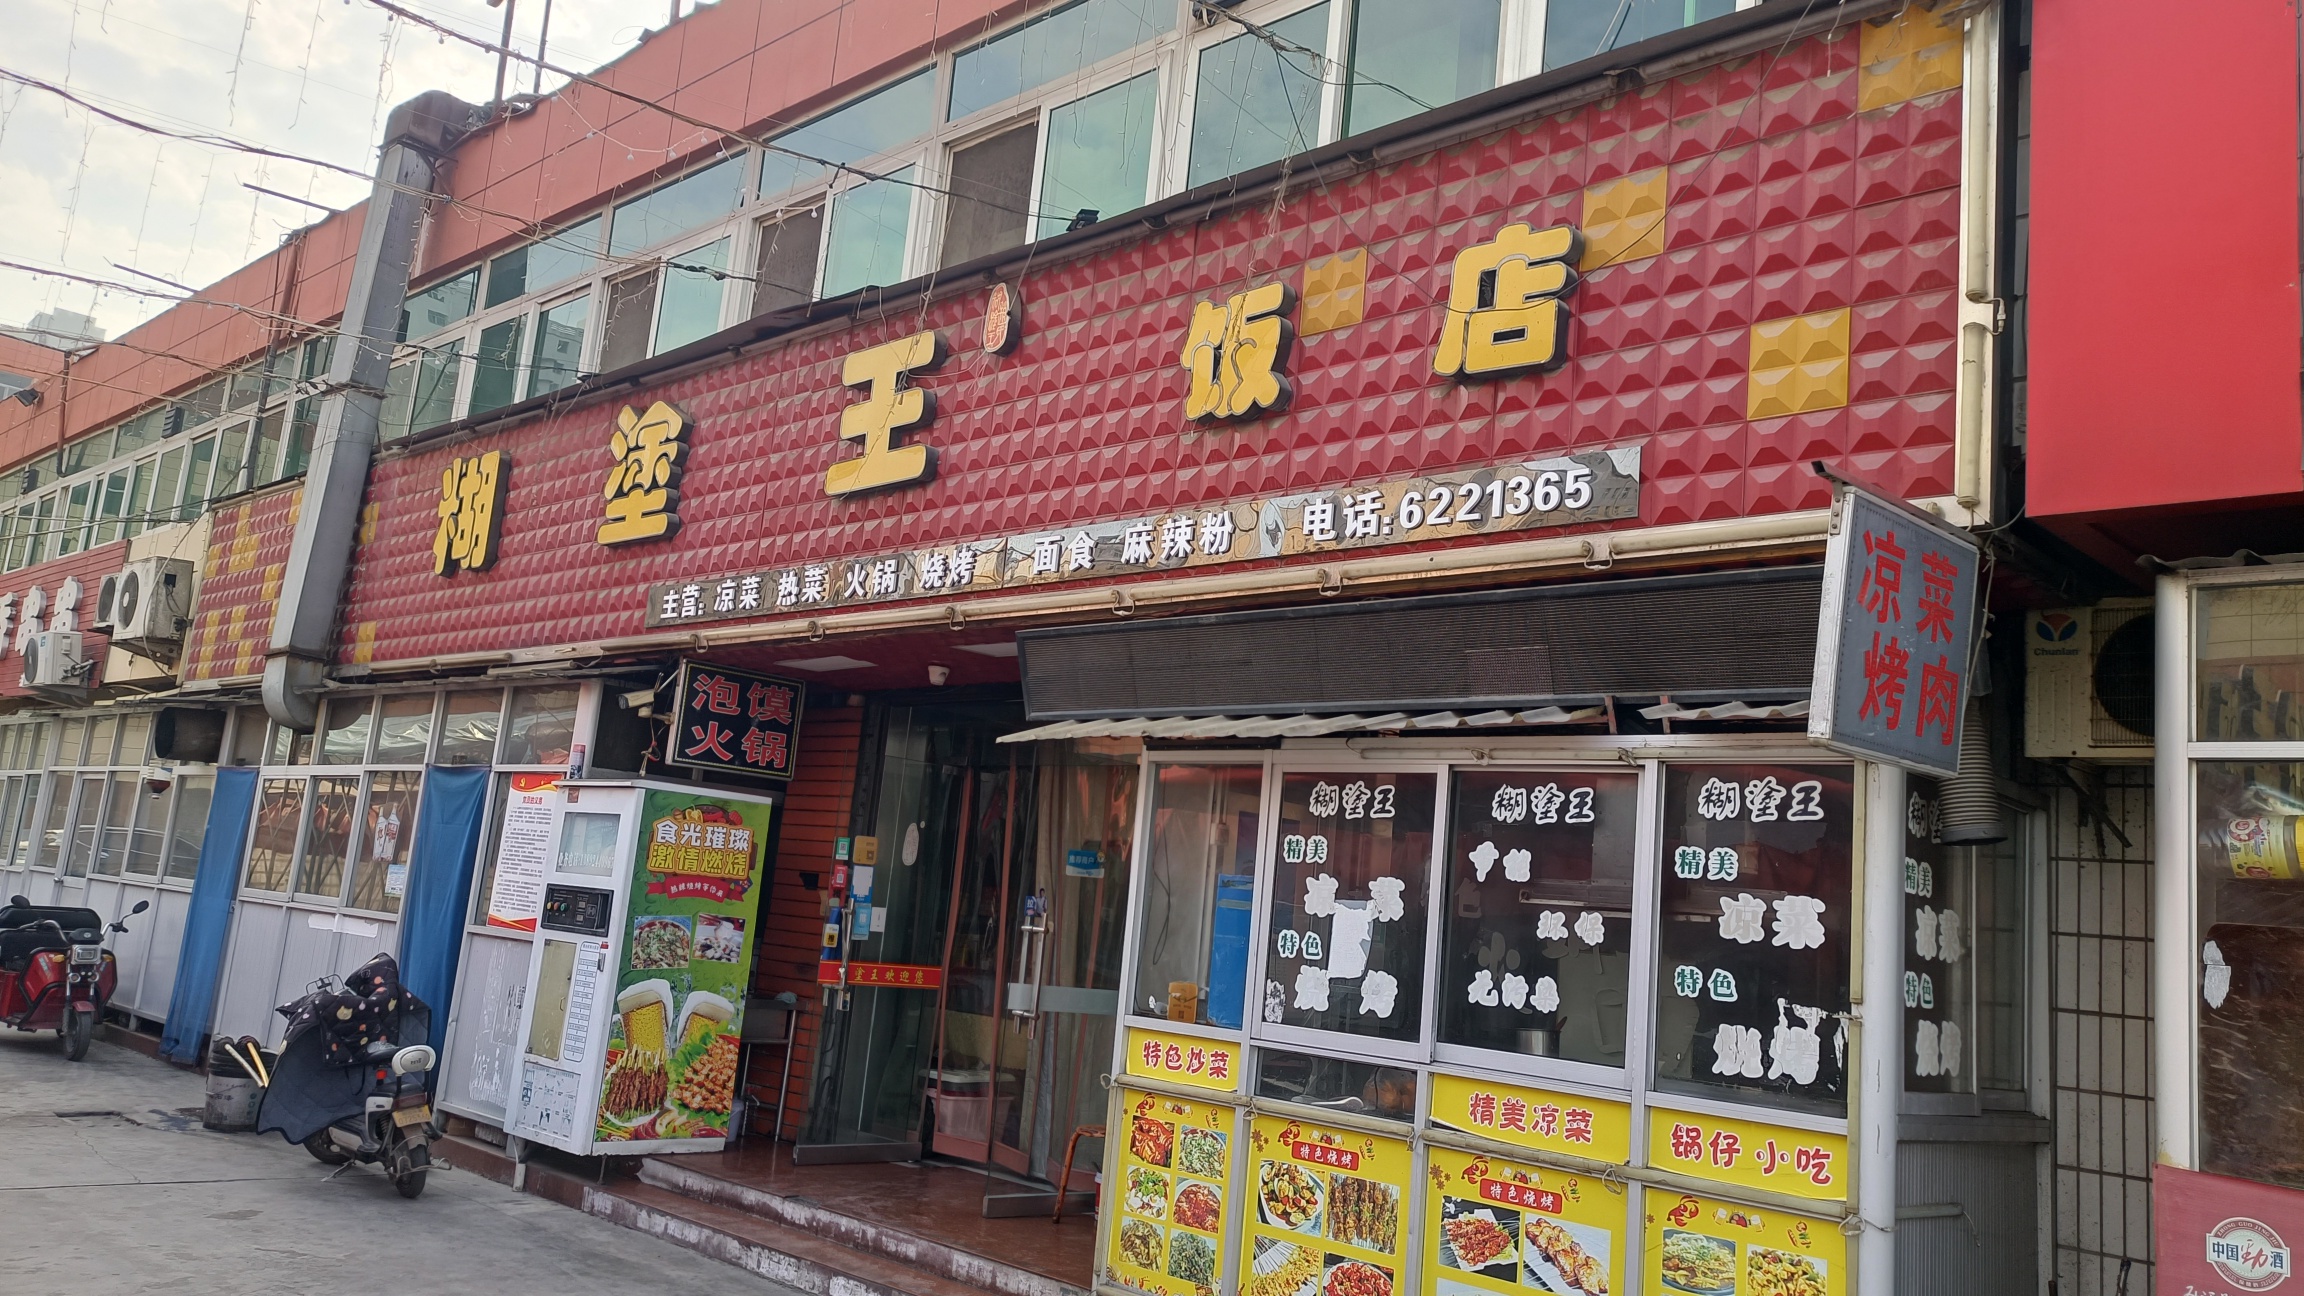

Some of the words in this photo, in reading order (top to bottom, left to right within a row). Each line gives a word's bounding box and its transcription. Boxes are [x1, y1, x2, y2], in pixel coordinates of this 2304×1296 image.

[713, 576, 761, 611] 凉菜
[776, 567, 827, 605] 热菜
[843, 559, 898, 598] 火锅
[919, 549, 976, 588] 烧烤
[1032, 534, 1096, 575] 面食
[1120, 511, 1234, 564] 麻辣粉
[692, 673, 794, 725] 泡馍
[685, 721, 787, 768] 火锅
[656, 820, 751, 851] 食光璀璨
[1283, 835, 1328, 863] 精美
[650, 845, 747, 876] 激情燃烧
[1675, 846, 1738, 881] 精美
[1905, 857, 1933, 898] 精美
[1278, 929, 1322, 960] 特色
[853, 965, 925, 985] 塗王欢迎您
[1674, 965, 1738, 1002] 特色
[1904, 971, 1934, 1009] 特色
[1142, 1039, 1230, 1080] 特色炒菜
[1469, 1091, 1593, 1144] 精美凉菜
[1299, 1145, 1353, 1168] 特色烧烤
[1490, 1183, 1555, 1212] 特色烧烤
[2217, 1222, 2236, 1236] ZHONG
[2254, 1225, 2271, 1238] JING
